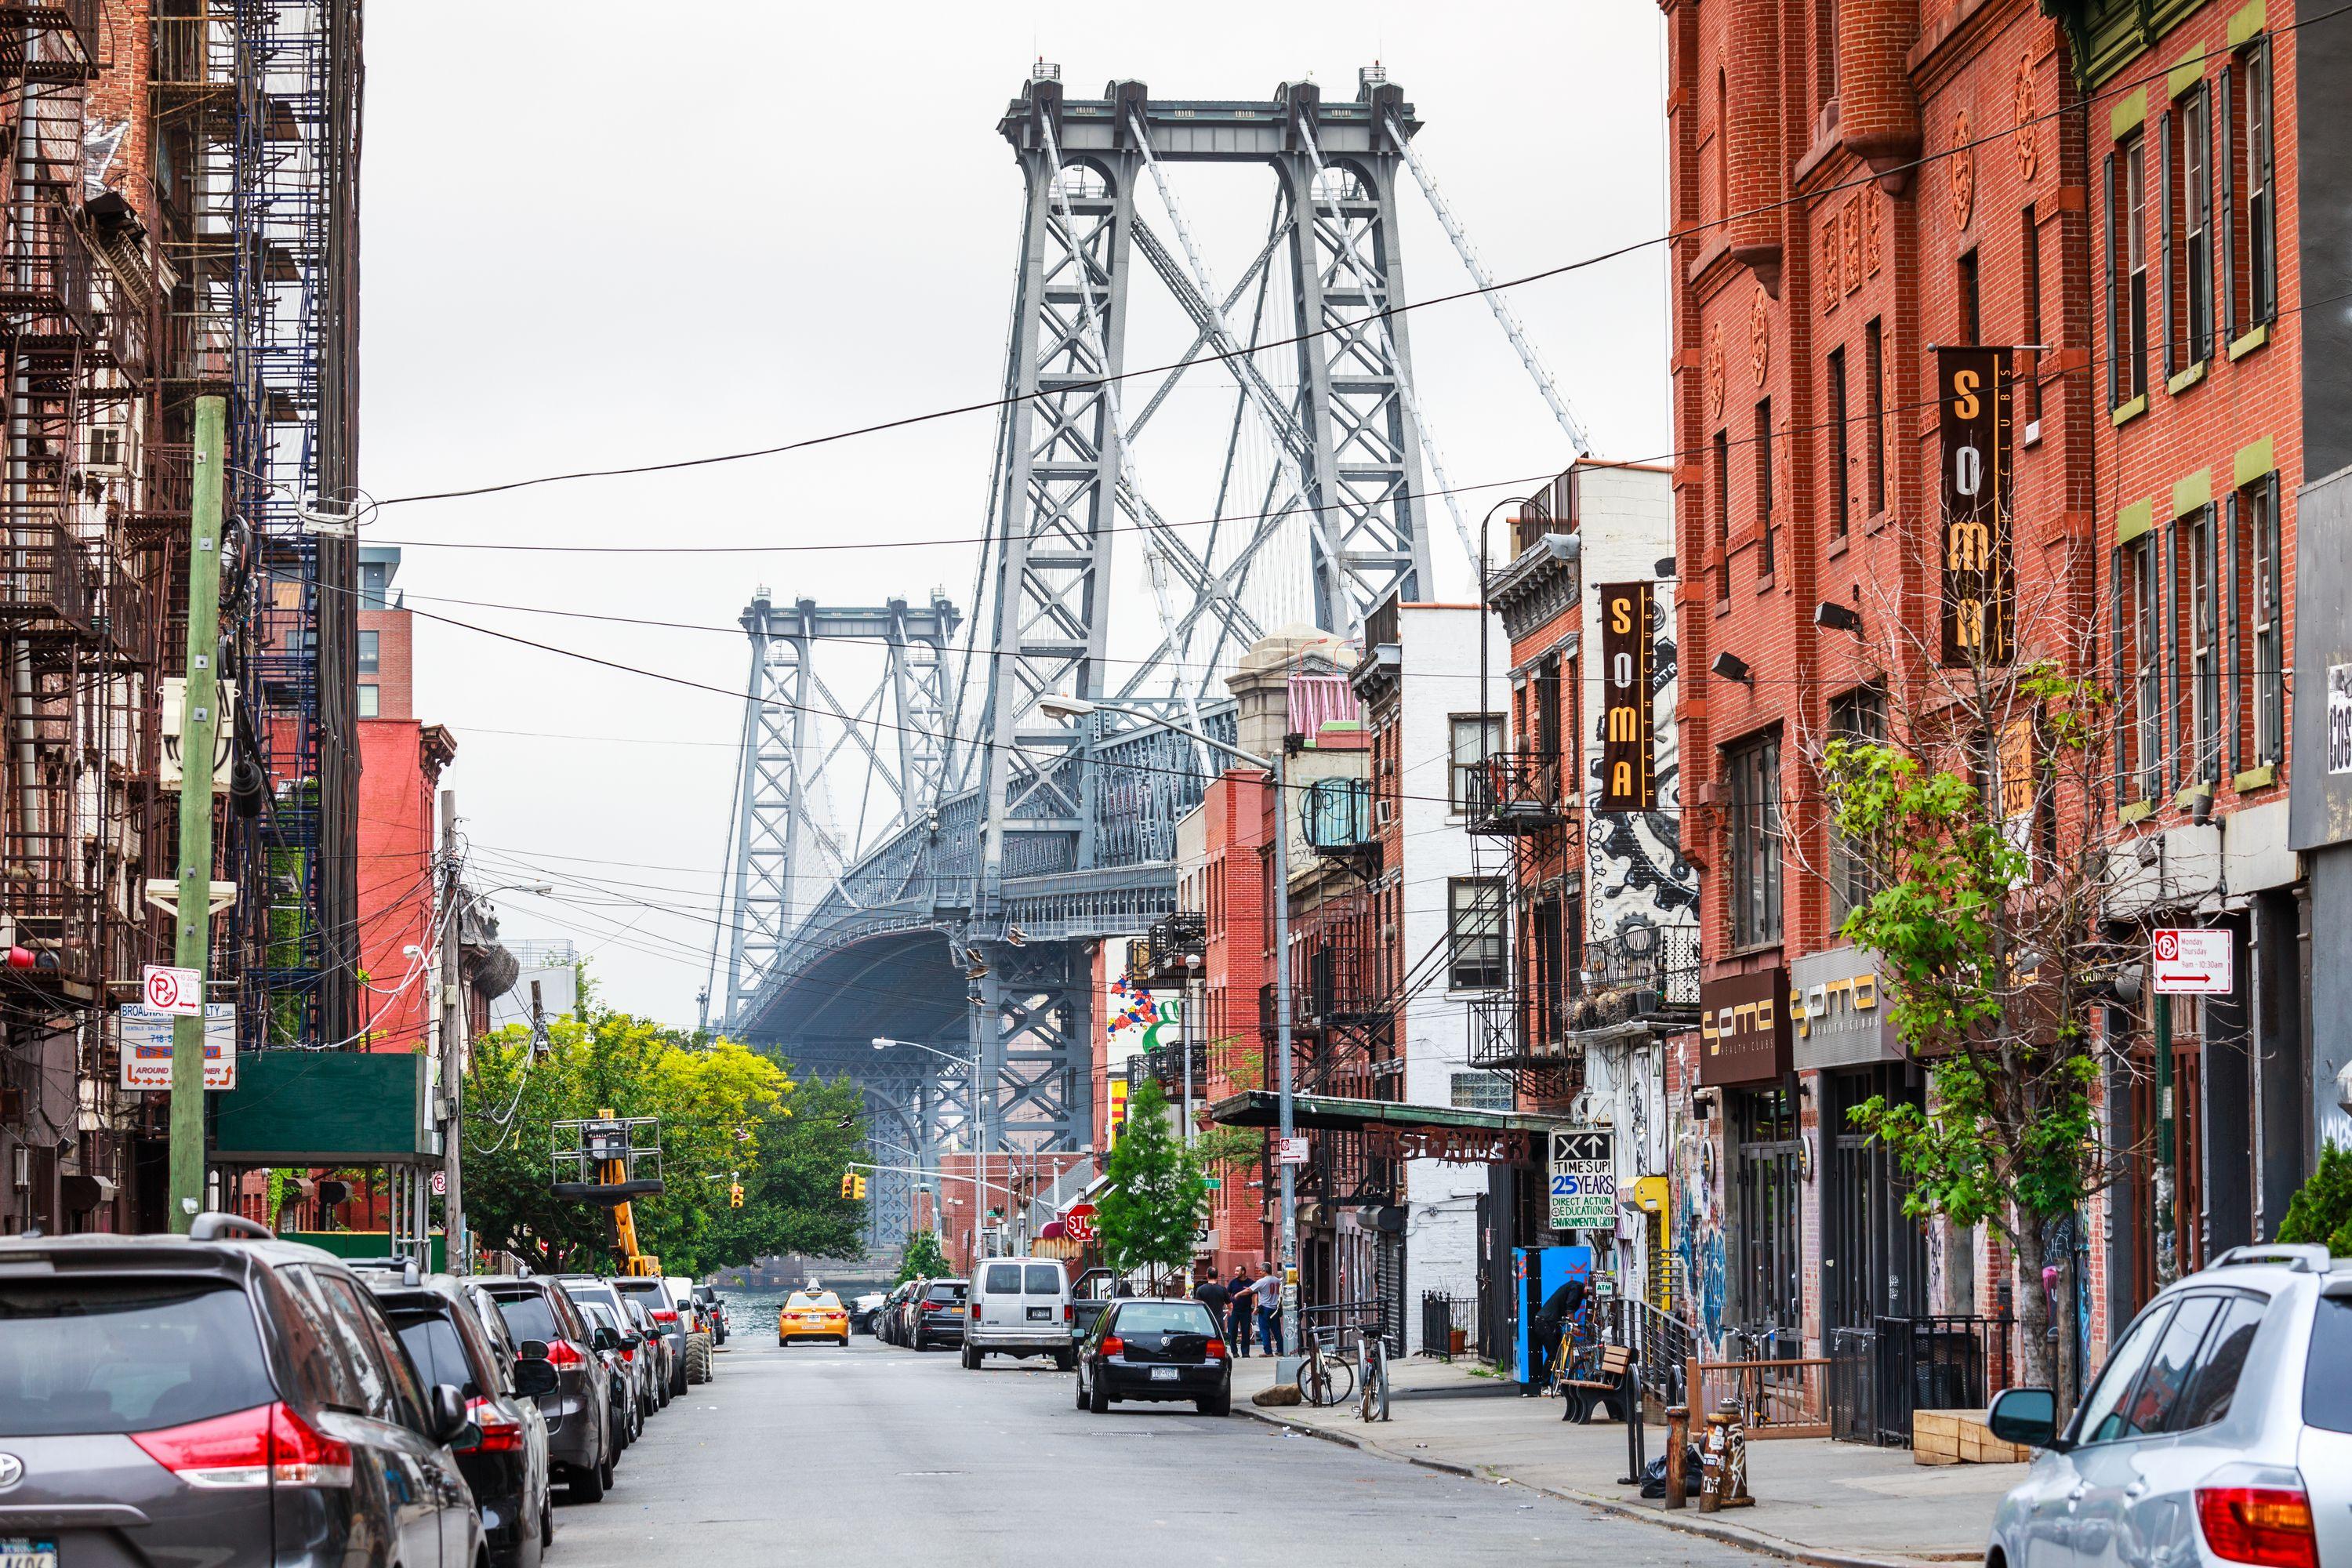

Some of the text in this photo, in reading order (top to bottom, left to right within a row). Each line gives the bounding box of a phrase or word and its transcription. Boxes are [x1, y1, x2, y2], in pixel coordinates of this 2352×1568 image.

[2000, 369, 2011, 475] CLUBS
[1949, 370, 1989, 646] SOMA
[1610, 597, 1636, 796] SOMA
[1644, 596, 1654, 796] HEALTH CLUBS
[1813, 1015, 1878, 1036] HEALTH CLUBS
[1721, 1038, 1773, 1055] HEALTH CLUBS
[1555, 1160, 1610, 1174] TIME'S UP!
[1552, 1175, 1615, 1195] 25 YEARS
[1552, 1196, 1611, 1206] DIRECT ACTION
[1559, 1206, 1603, 1216] EDUCATION
[1552, 1216, 1615, 1227] ENVIRONMENTAL GROUP
